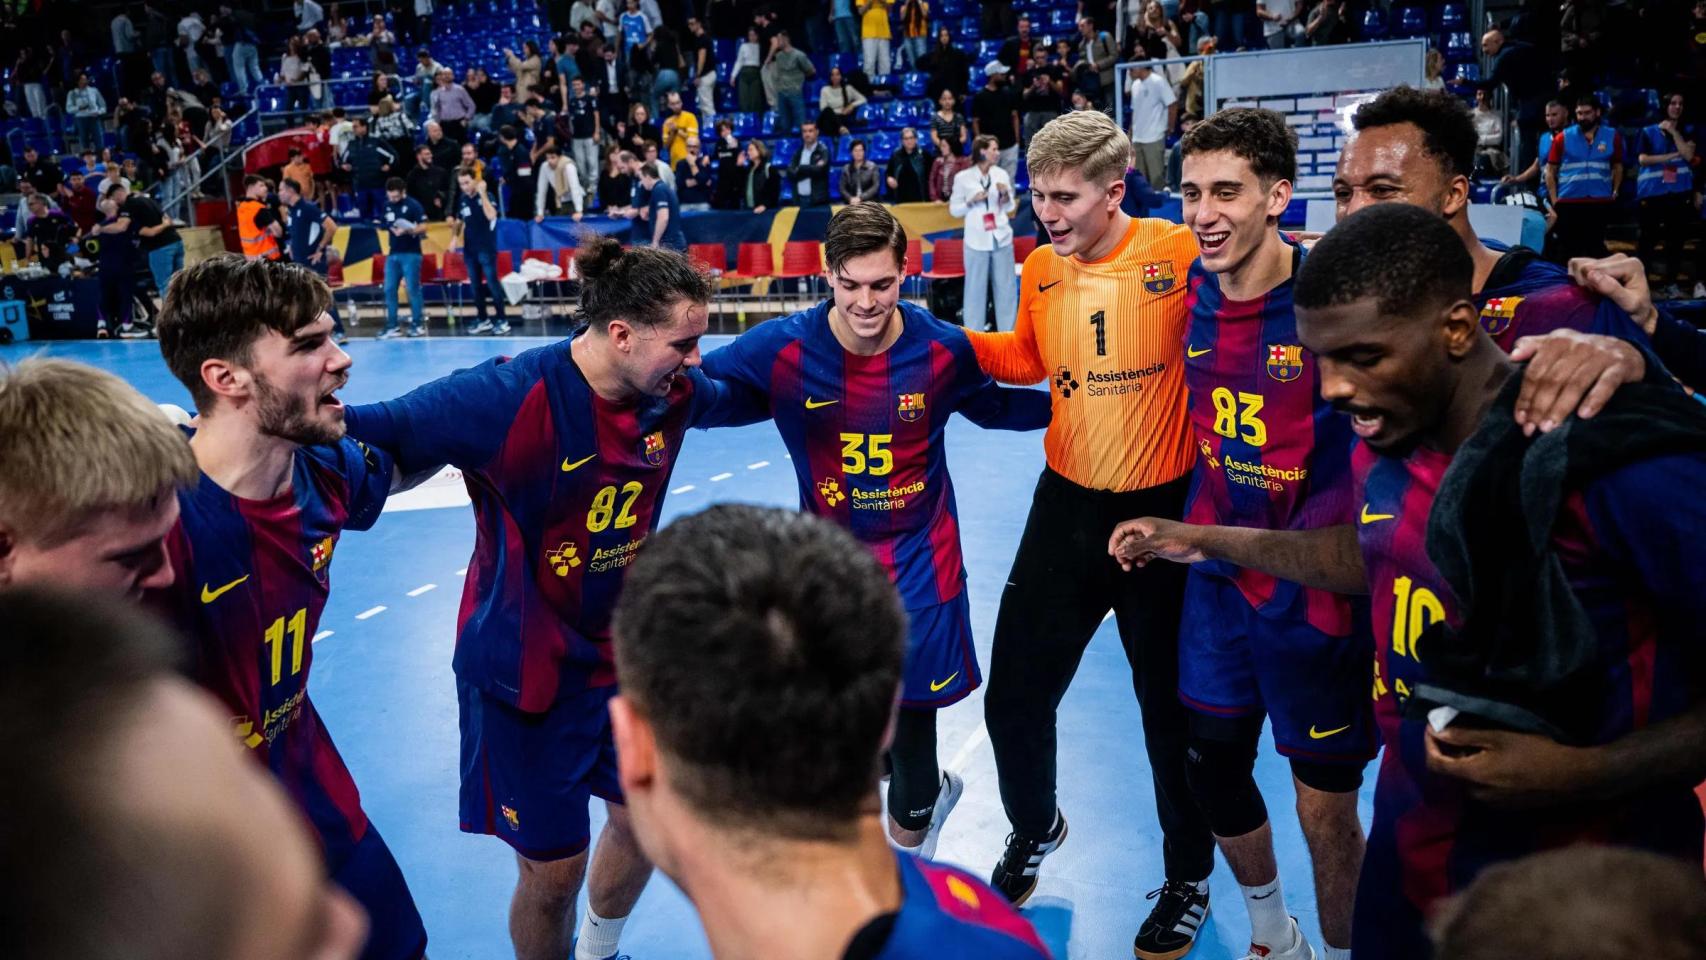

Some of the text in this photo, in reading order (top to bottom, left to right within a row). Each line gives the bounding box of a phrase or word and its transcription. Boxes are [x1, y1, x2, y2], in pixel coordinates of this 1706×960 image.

[1090, 311, 1106, 356] 1
[1087, 363, 1166, 382] Assistència
[1088, 382, 1143, 397] Sanitària
[1212, 387, 1267, 447] 83
[840, 433, 894, 476] 35
[1224, 455, 1307, 481] Assistència
[852, 481, 925, 499] Assistència
[1227, 468, 1284, 492] Sanitària
[586, 481, 643, 533] 82
[853, 498, 905, 511] Sanitària
[1393, 576, 1446, 663] 10
[265, 608, 307, 686] 11
